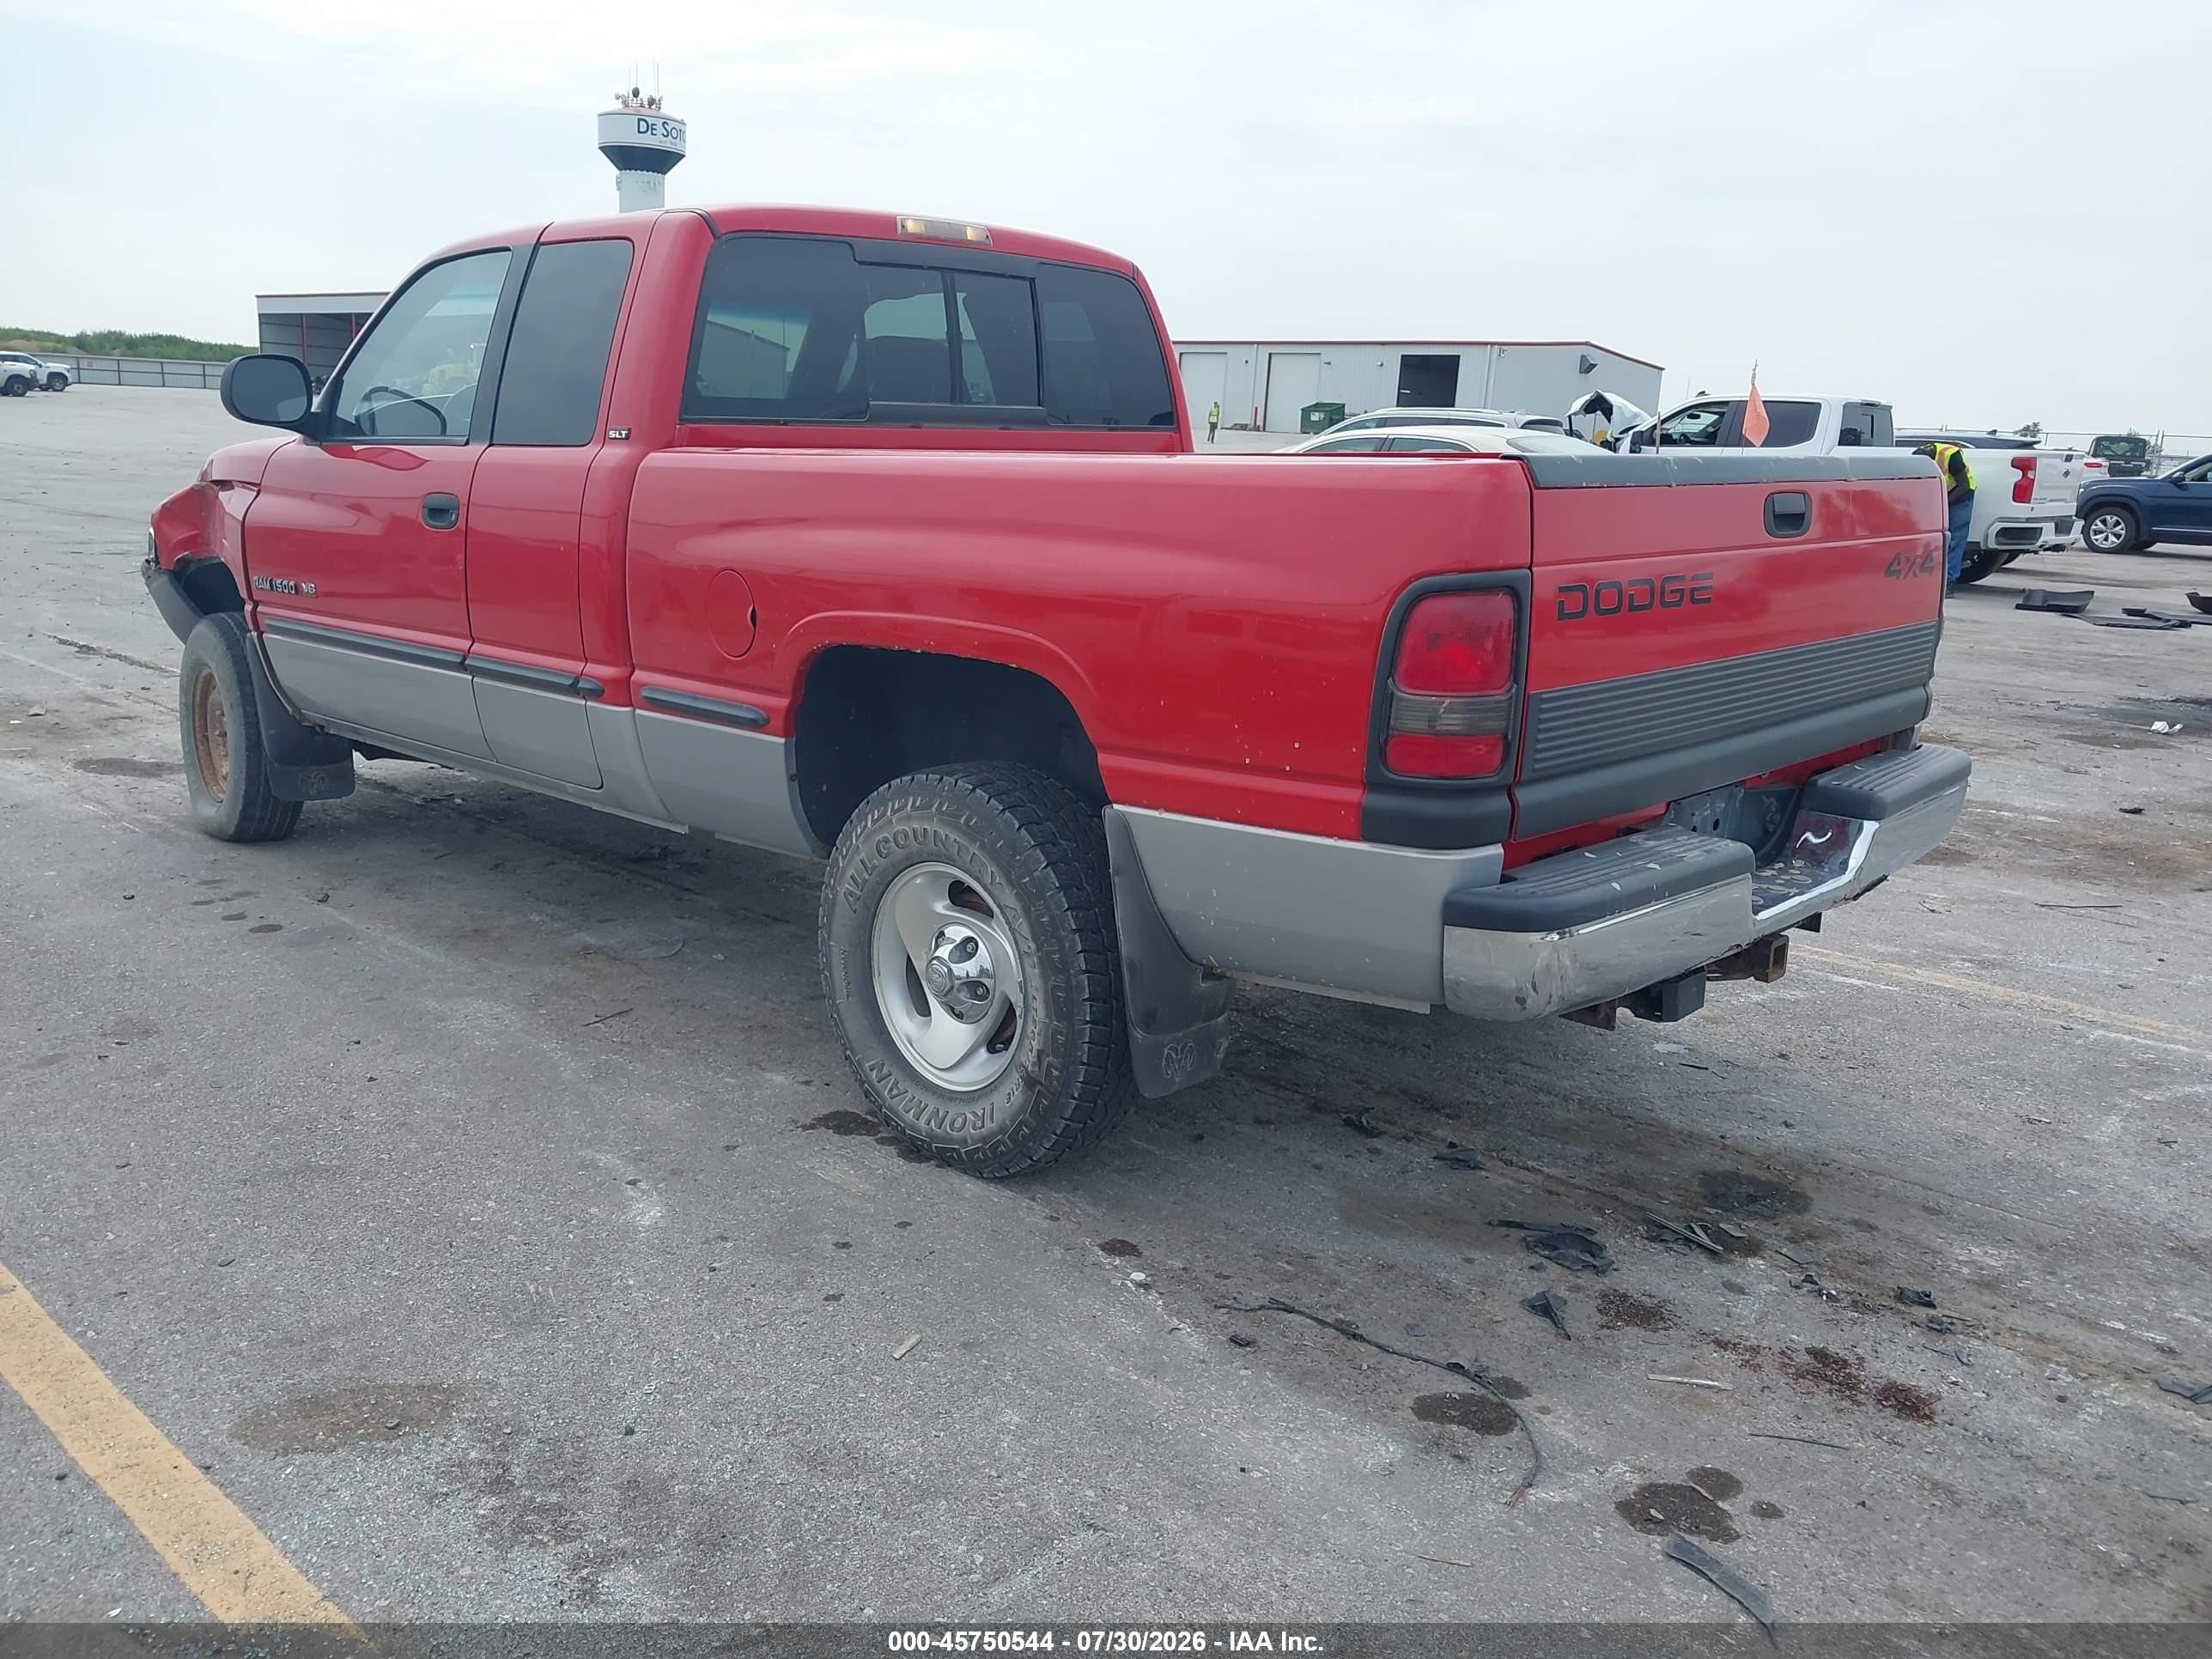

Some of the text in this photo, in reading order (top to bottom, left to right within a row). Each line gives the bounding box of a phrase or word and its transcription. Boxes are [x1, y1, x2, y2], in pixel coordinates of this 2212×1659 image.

[608, 430, 628, 439] SLT
[252, 576, 270, 590] RAM
[272, 578, 296, 594] 1500
[1557, 571, 1714, 622] DODGE
[842, 853, 878, 915] ALL
[875, 824, 1005, 888] COUNTRY
[865, 1057, 996, 1133] IRONMAN
